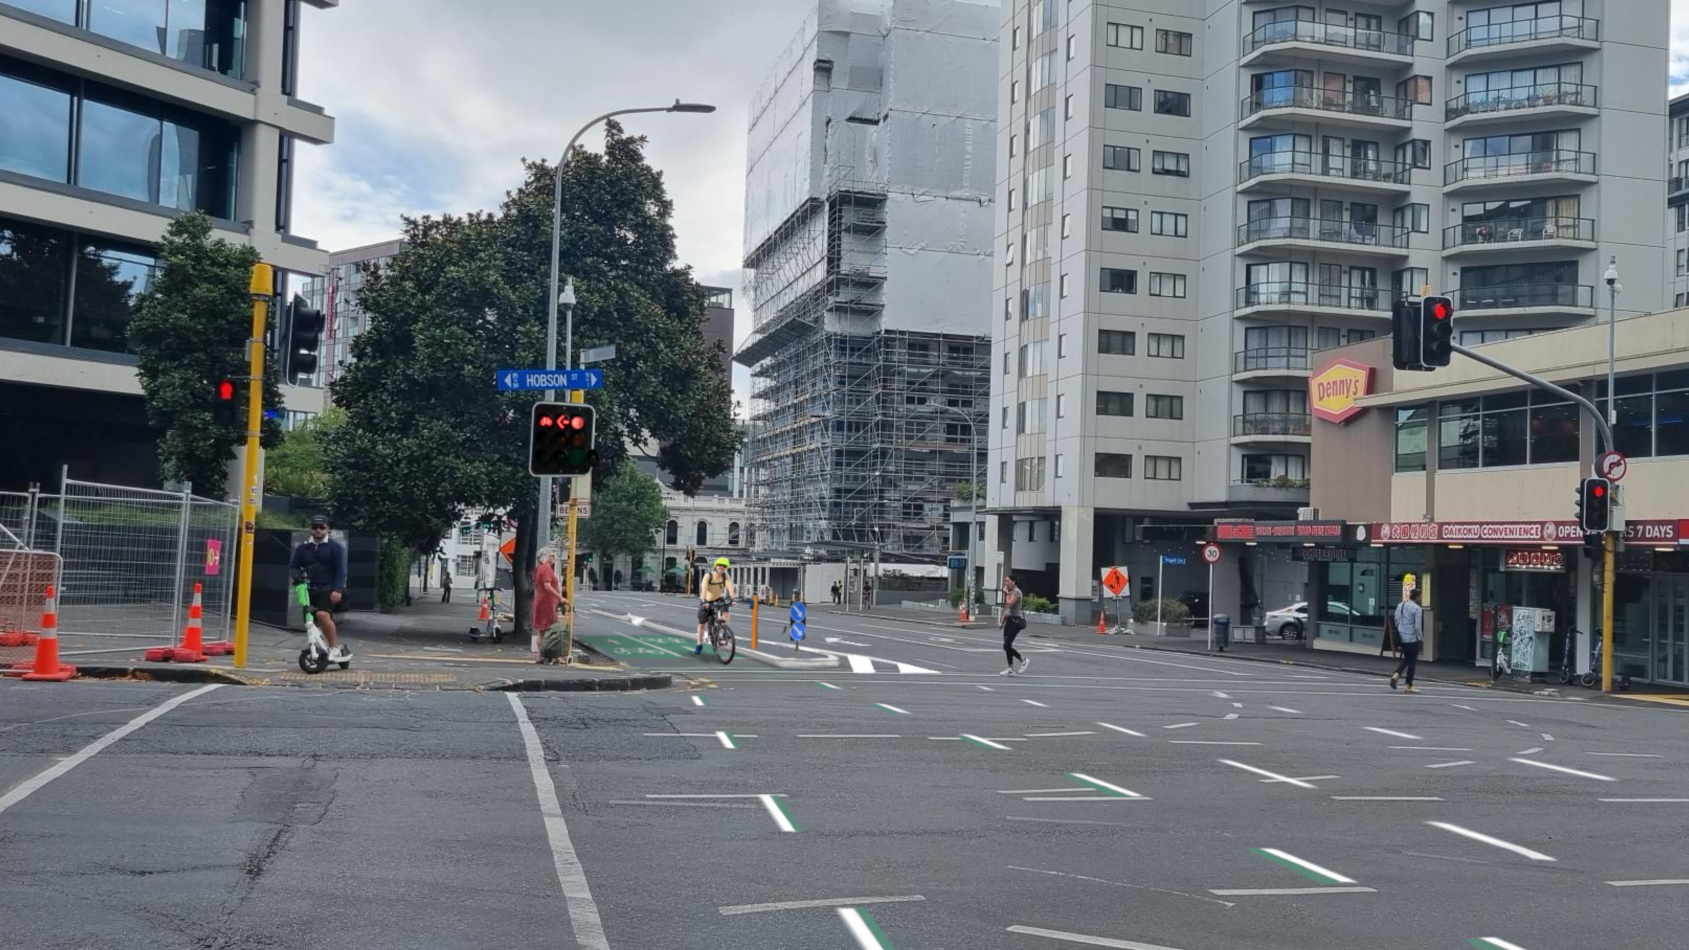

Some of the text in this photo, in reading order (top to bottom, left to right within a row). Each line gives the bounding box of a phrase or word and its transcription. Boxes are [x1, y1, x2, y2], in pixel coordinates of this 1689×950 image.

[526, 373, 568, 388] HOBSON
[1317, 375, 1360, 403] Denny's
[559, 506, 588, 515] BENS
[1442, 524, 1541, 539] DAIKOKU CONVENIENCE
[1558, 525, 1583, 538] OPEN
[1636, 525, 1643, 538] 7
[1645, 525, 1674, 539] DAYS
[1207, 549, 1217, 558] 30
